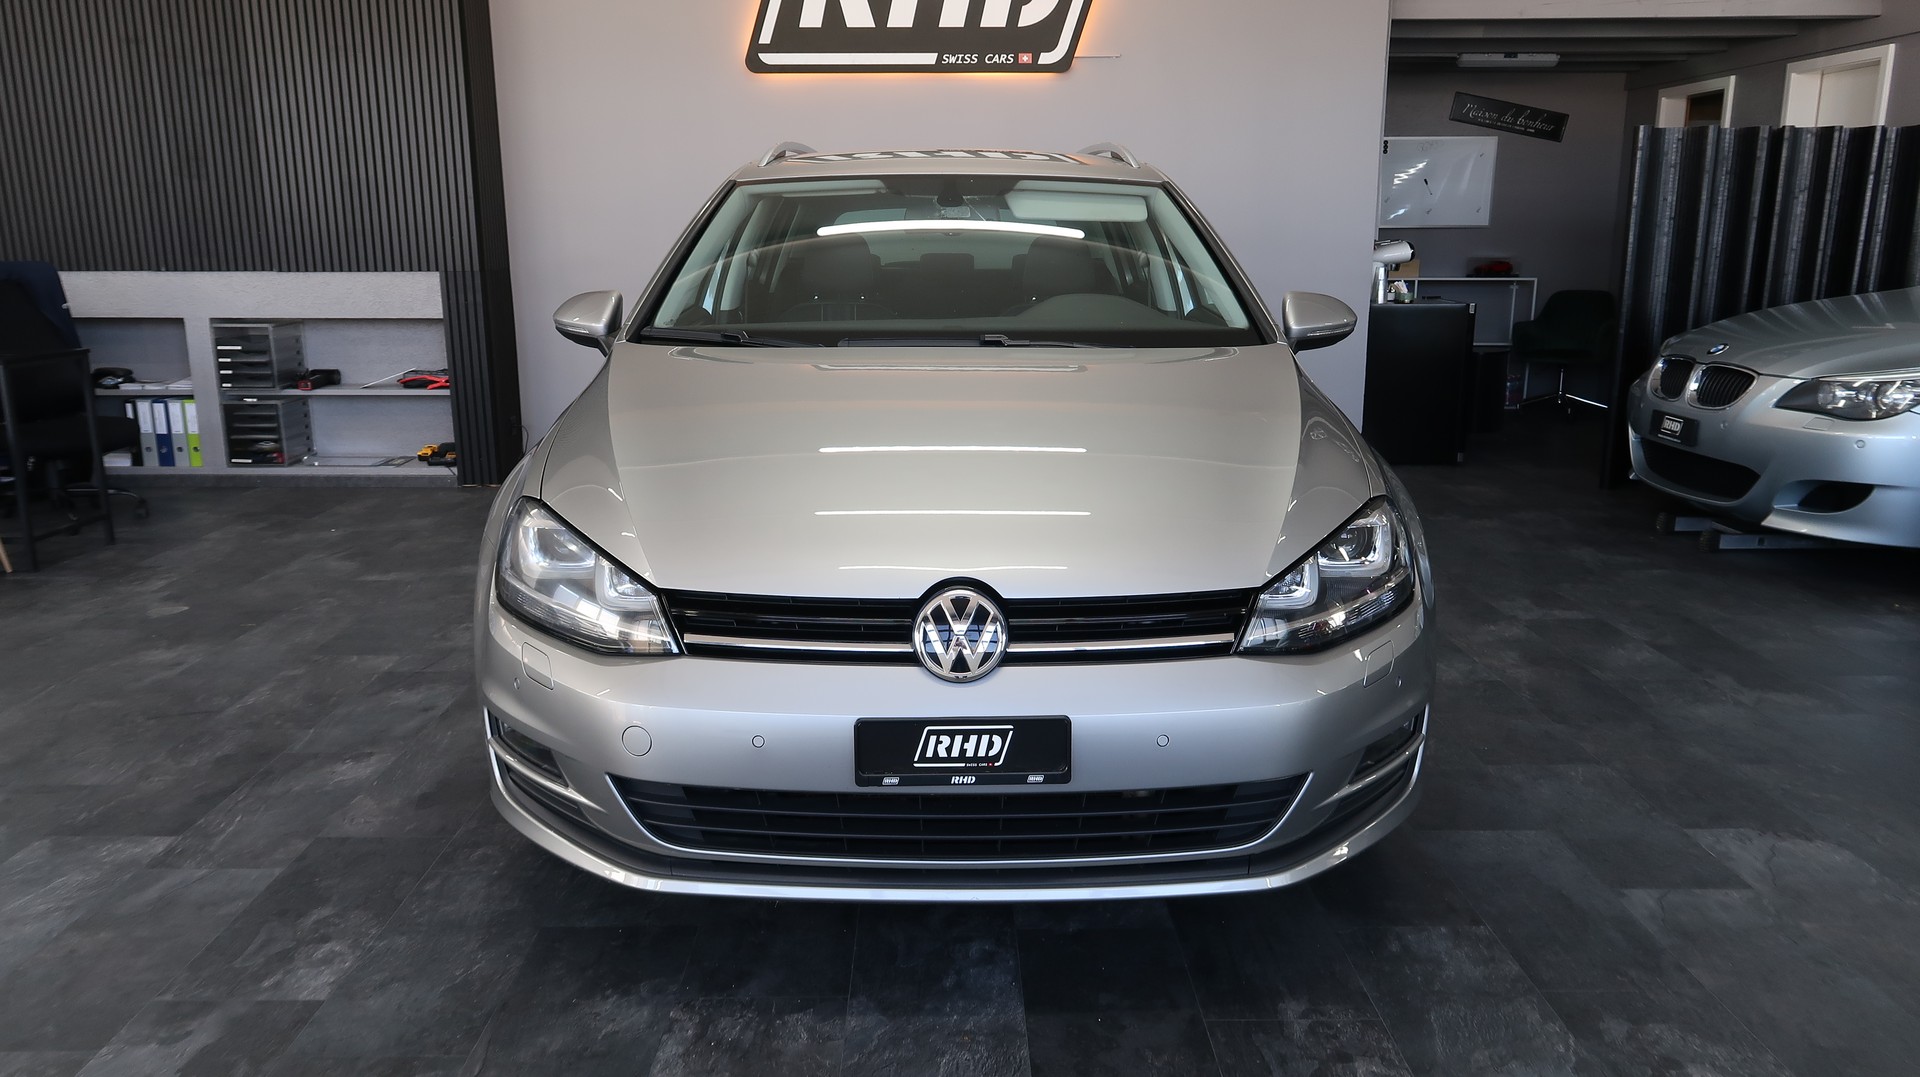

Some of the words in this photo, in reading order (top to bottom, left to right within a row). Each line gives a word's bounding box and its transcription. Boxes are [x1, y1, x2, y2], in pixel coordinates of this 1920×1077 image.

[942, 53, 978, 64] SWISS
[985, 53, 1014, 64] CARS
[1462, 103, 1498, 118] Maison
[1501, 107, 1516, 123] du
[1517, 109, 1555, 131] bonheur
[1663, 419, 1681, 432] RHD
[925, 734, 1002, 758] RHD
[951, 776, 976, 784] RHD
